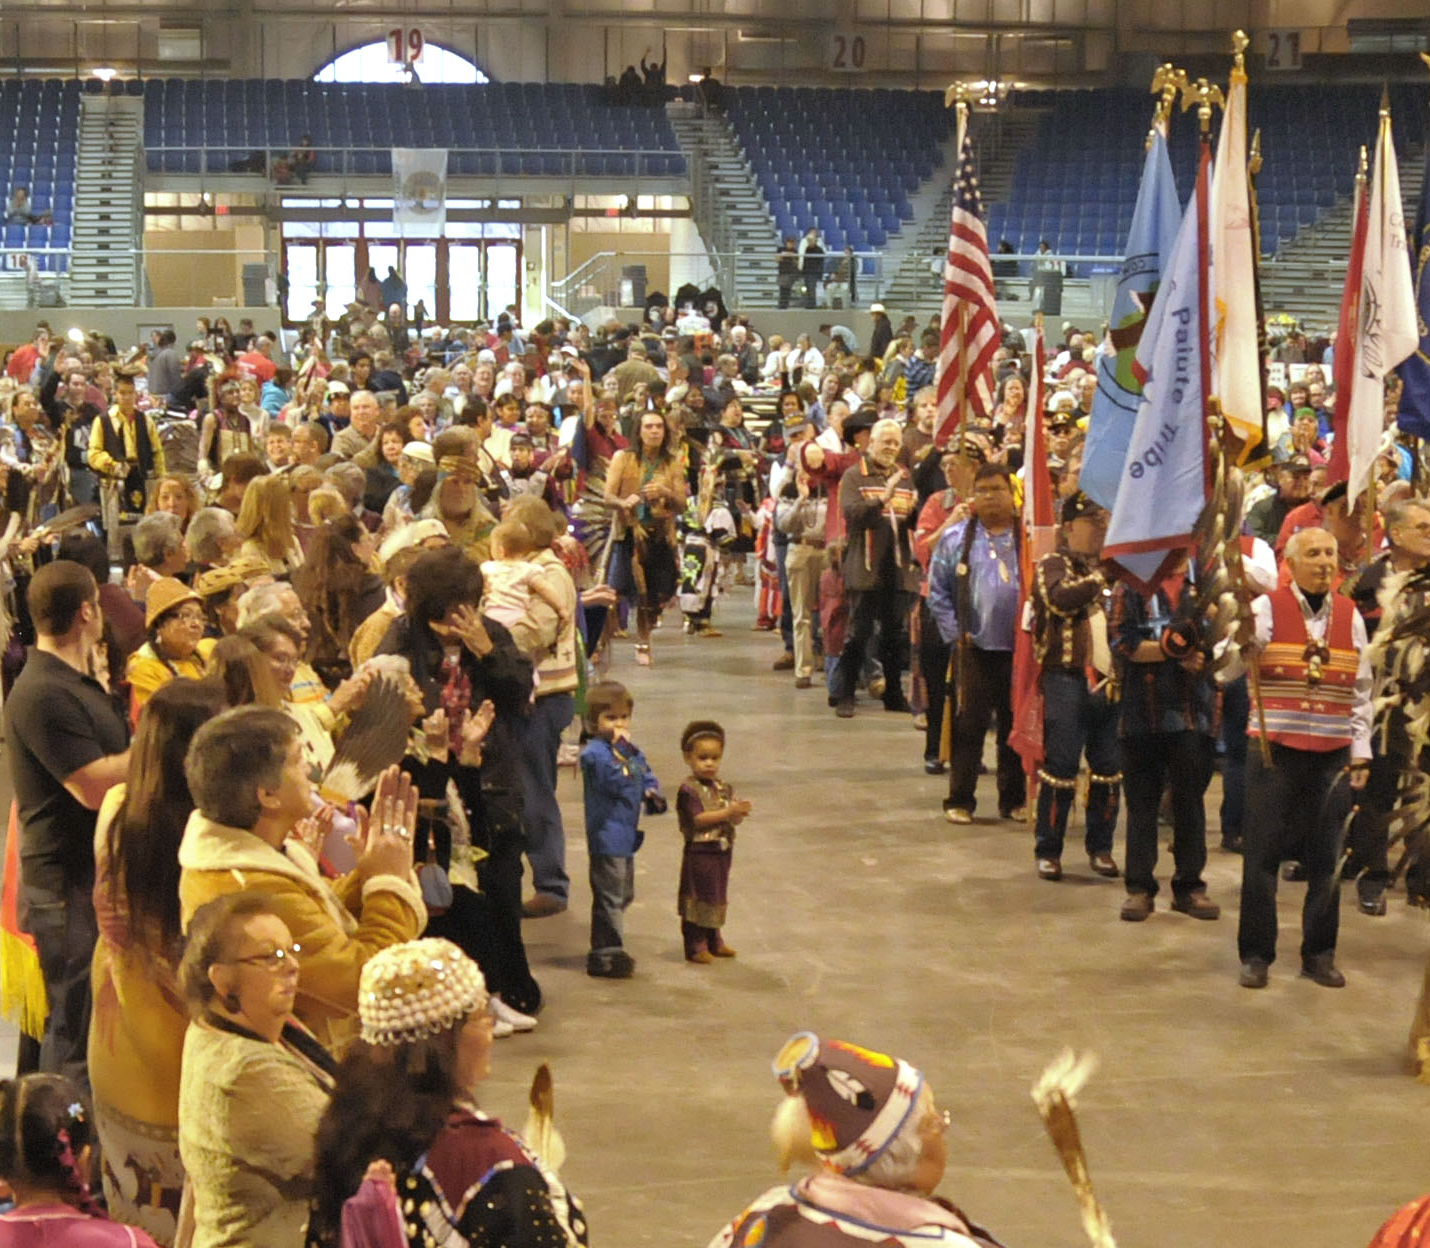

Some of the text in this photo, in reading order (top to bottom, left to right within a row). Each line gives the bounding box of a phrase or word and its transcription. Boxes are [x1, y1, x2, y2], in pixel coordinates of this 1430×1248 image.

[388, 28, 423, 62] 19
[834, 36, 867, 69] 20
[1269, 32, 1300, 67] 21
[1129, 306, 1194, 479] Paiute Tribe
